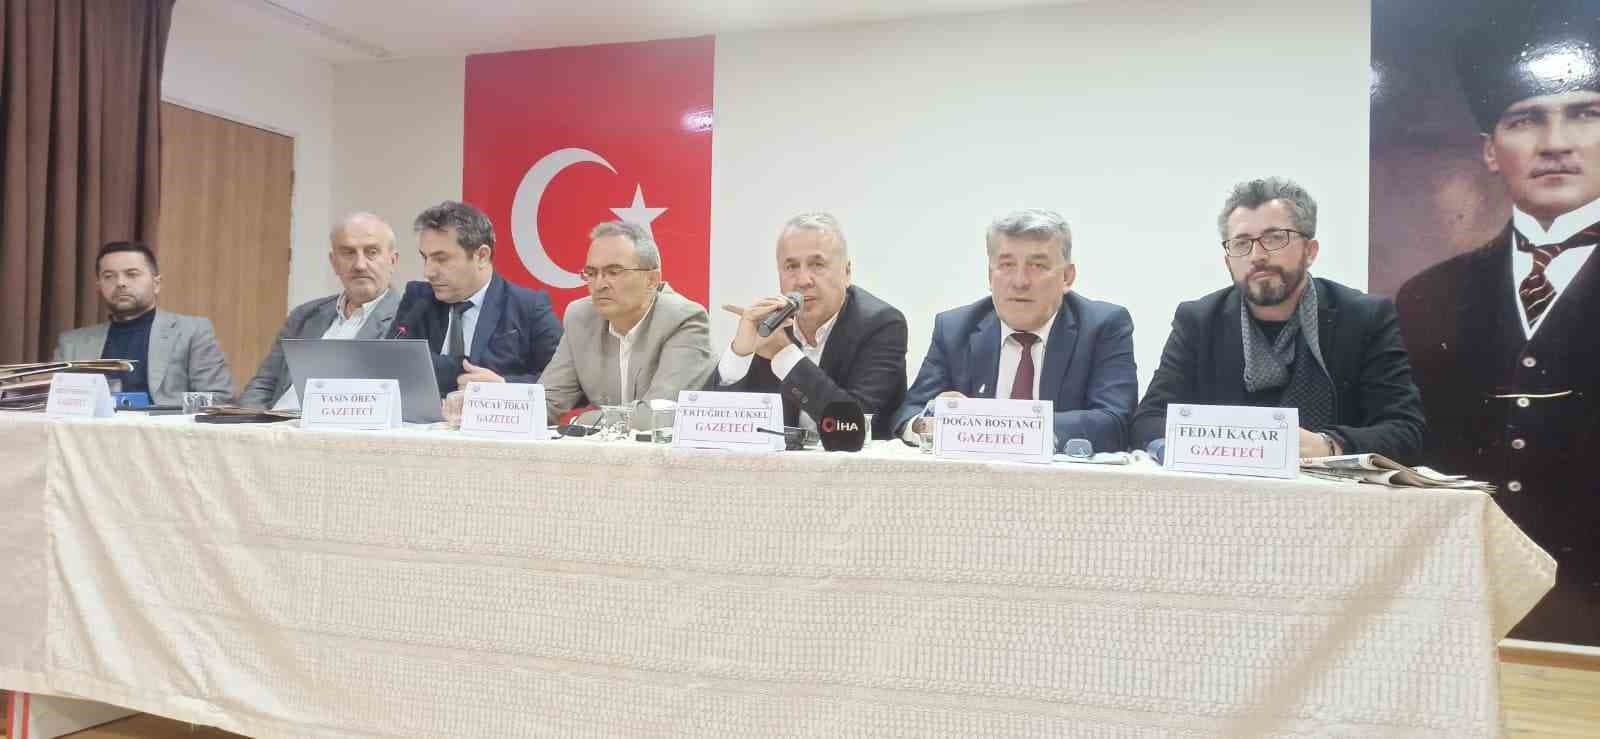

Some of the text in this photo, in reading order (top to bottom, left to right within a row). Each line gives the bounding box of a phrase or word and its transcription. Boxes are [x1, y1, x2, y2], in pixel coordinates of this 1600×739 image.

[943, 414, 982, 426] DOĞAN
[1225, 428, 1279, 443] KAÇAR
[1190, 443, 1264, 459] GAZETECİ
